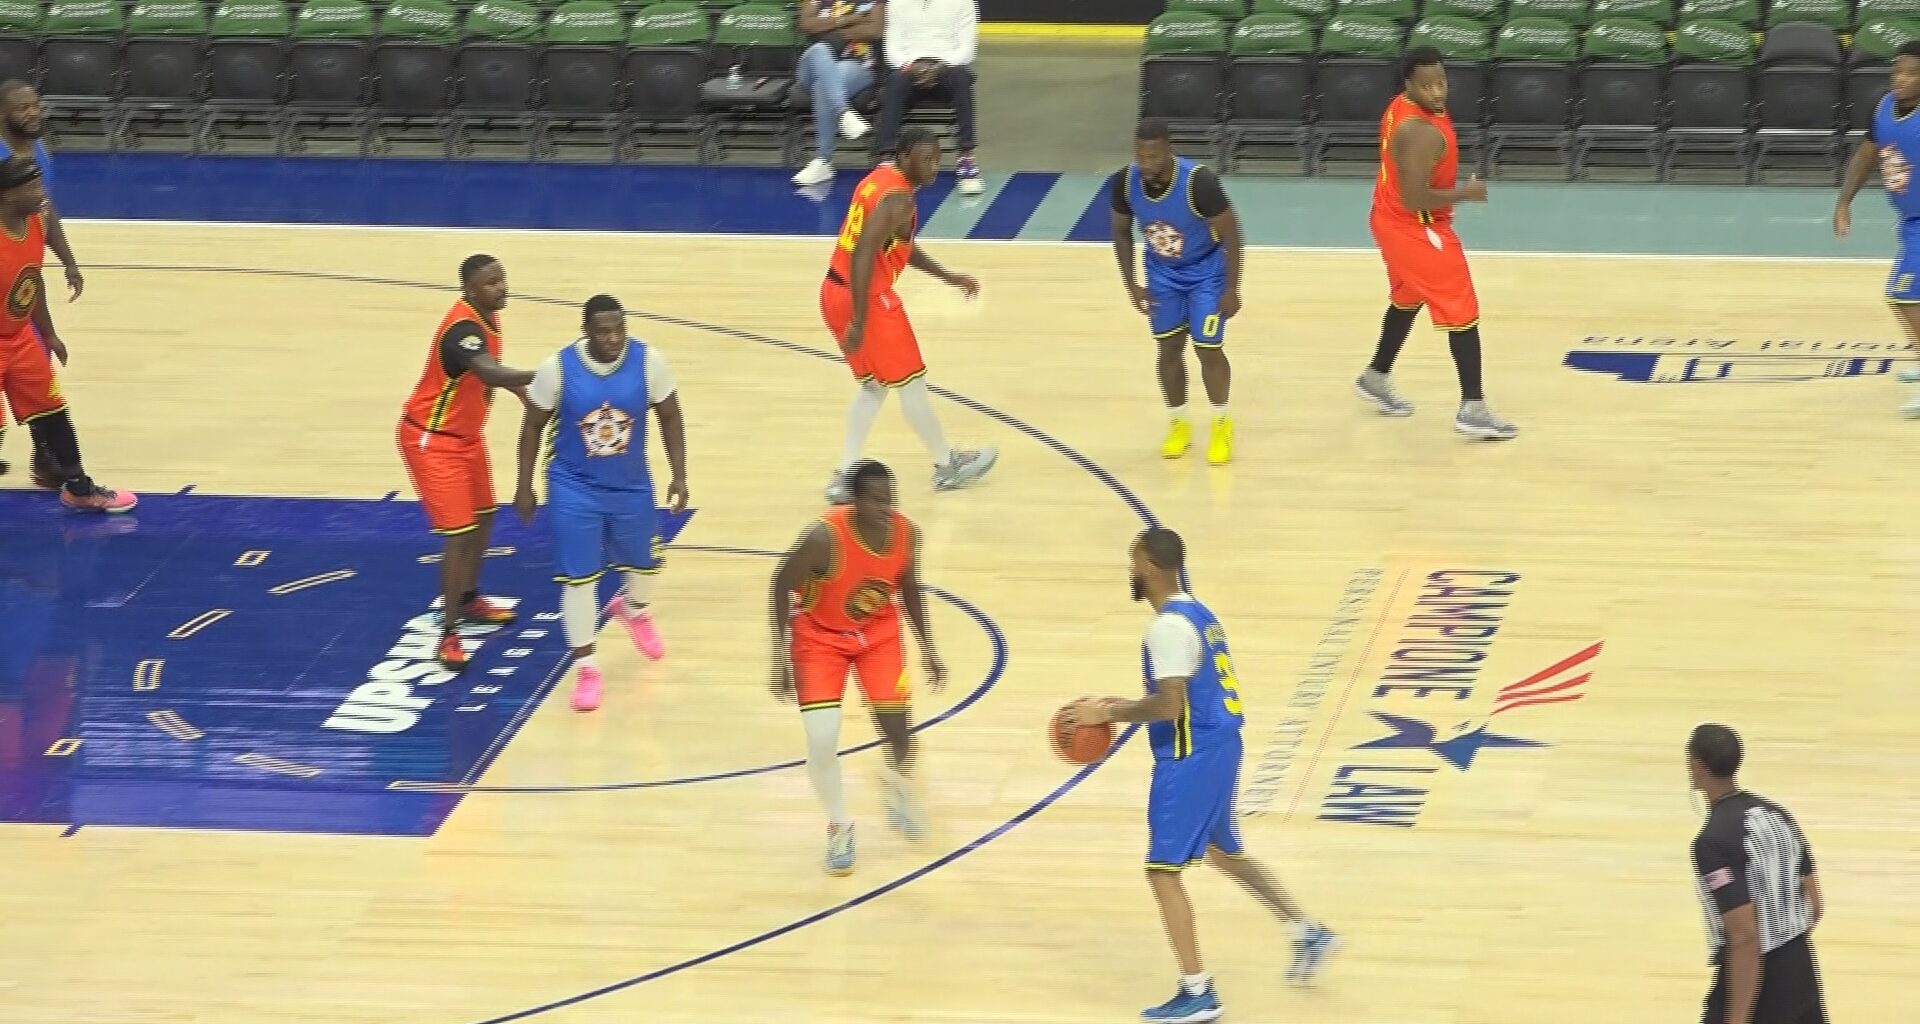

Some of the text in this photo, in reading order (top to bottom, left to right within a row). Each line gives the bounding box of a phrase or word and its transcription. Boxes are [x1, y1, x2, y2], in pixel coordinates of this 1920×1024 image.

[1203, 314, 1220, 338] 0
[1582, 336, 1738, 351] Arena
[455, 611, 564, 712] LEAGUE
[1315, 569, 1522, 828] CAMPIONE LAW
